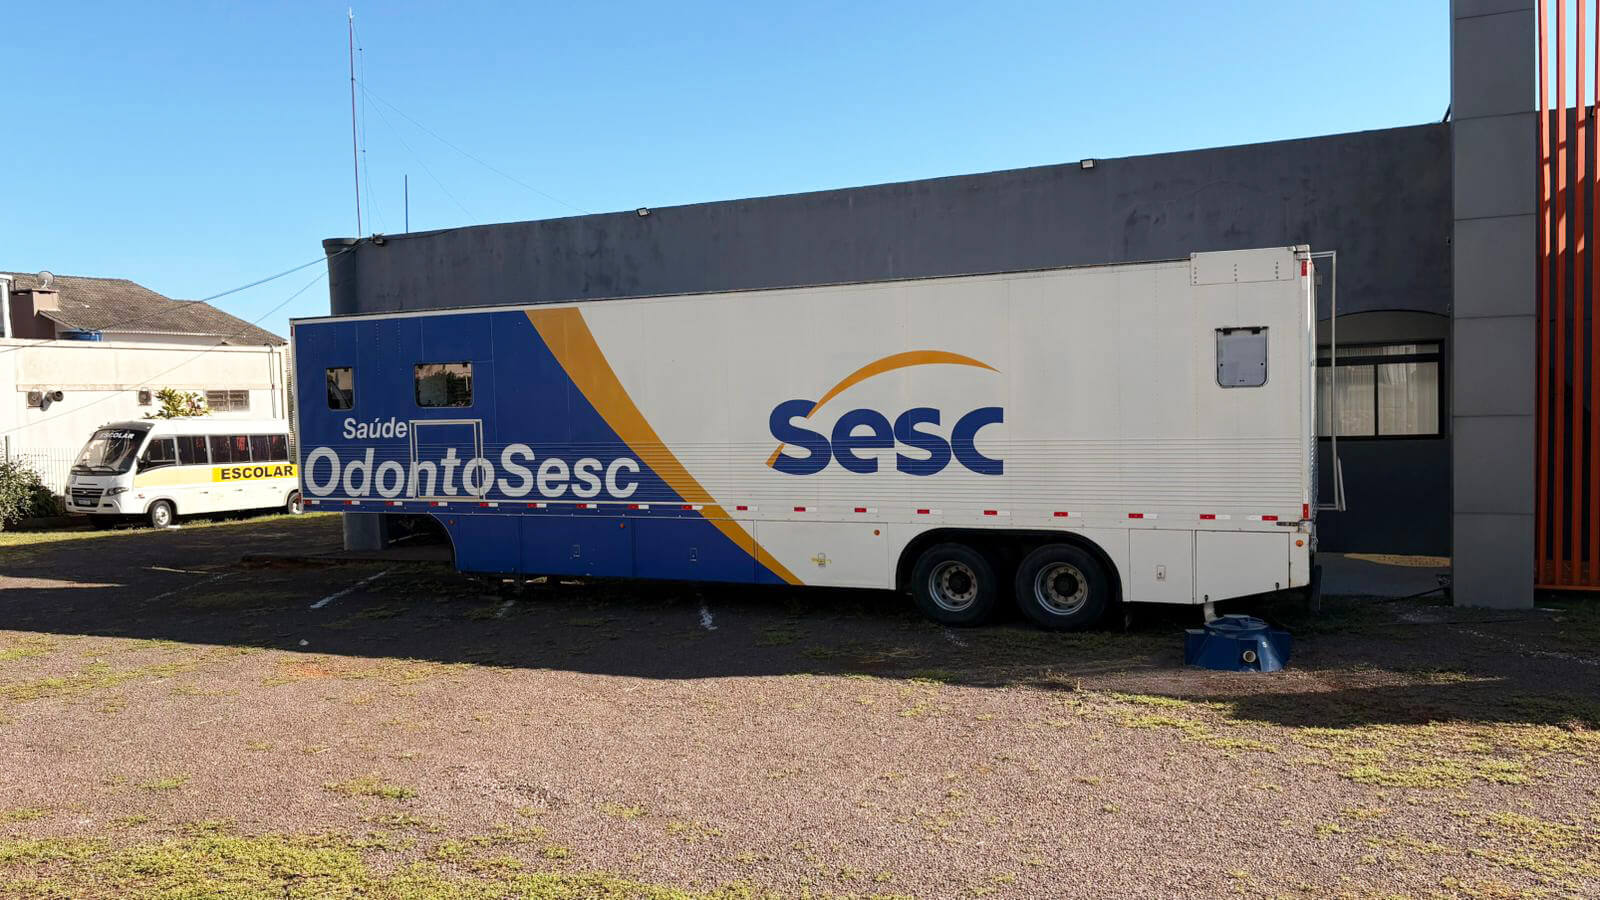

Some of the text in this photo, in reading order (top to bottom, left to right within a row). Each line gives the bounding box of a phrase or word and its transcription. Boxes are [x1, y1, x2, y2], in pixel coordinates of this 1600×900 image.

[342, 416, 408, 440] Saúde
[220, 465, 294, 480] ESCOLAR
[304, 443, 641, 498] OdontoSesc
